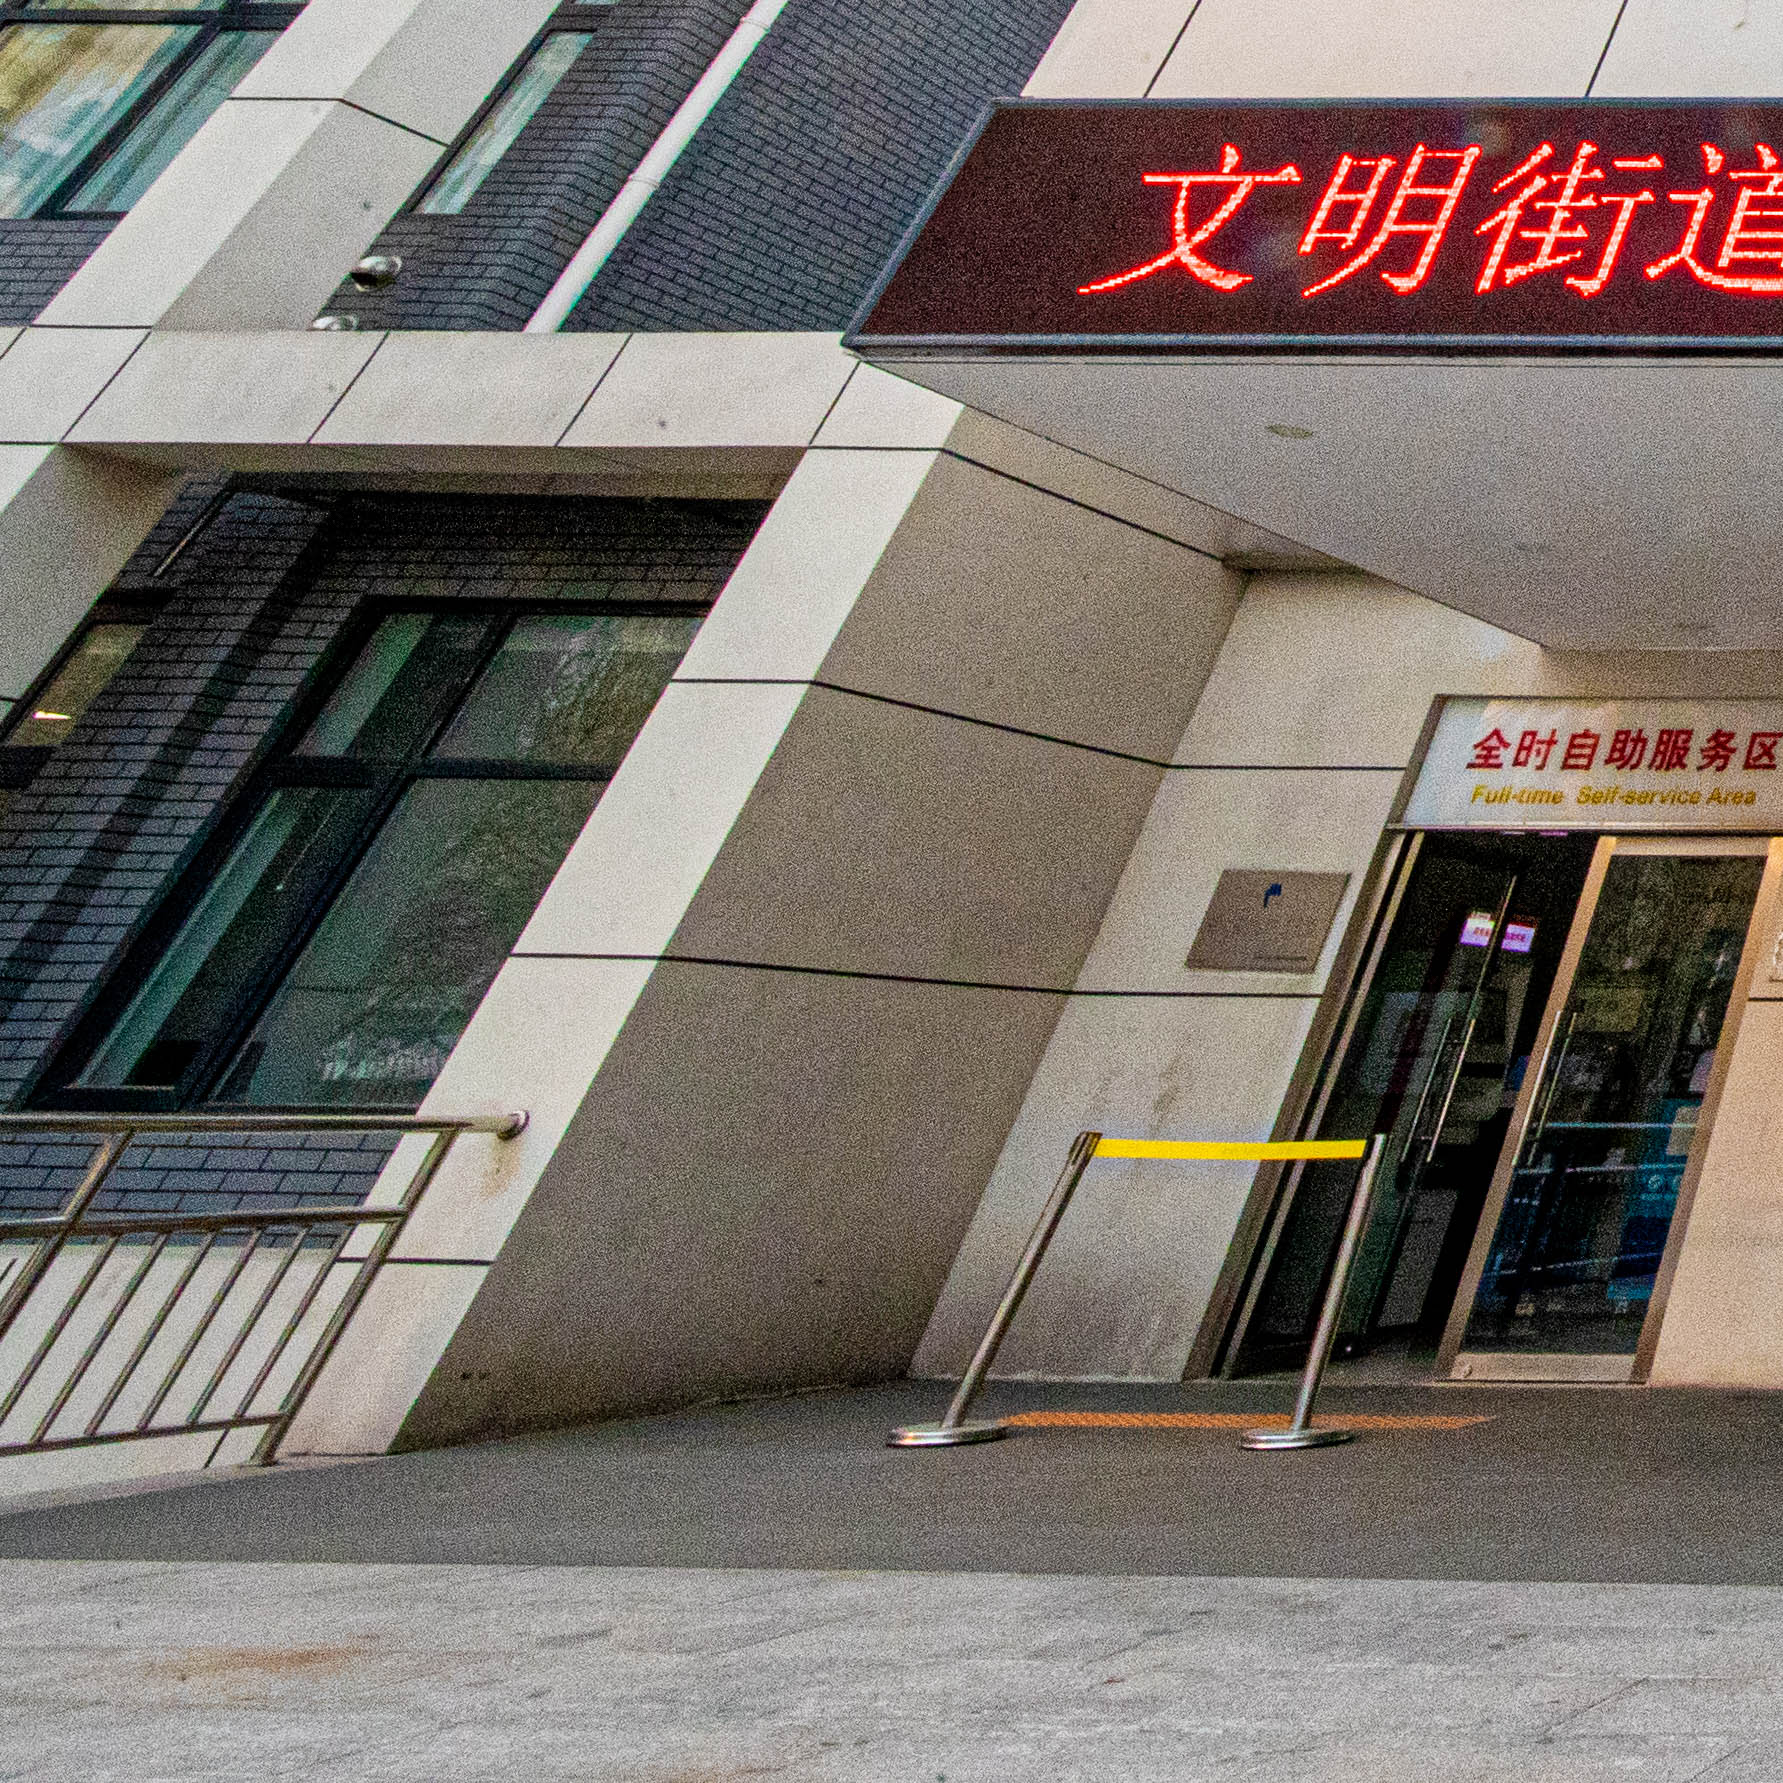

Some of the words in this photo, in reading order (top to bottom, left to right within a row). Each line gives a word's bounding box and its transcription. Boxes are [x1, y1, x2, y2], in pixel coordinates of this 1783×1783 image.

[1470, 783, 1565, 805] Full-time
[1576, 784, 1702, 807] Self-service
[1706, 787, 1757, 807] Area
